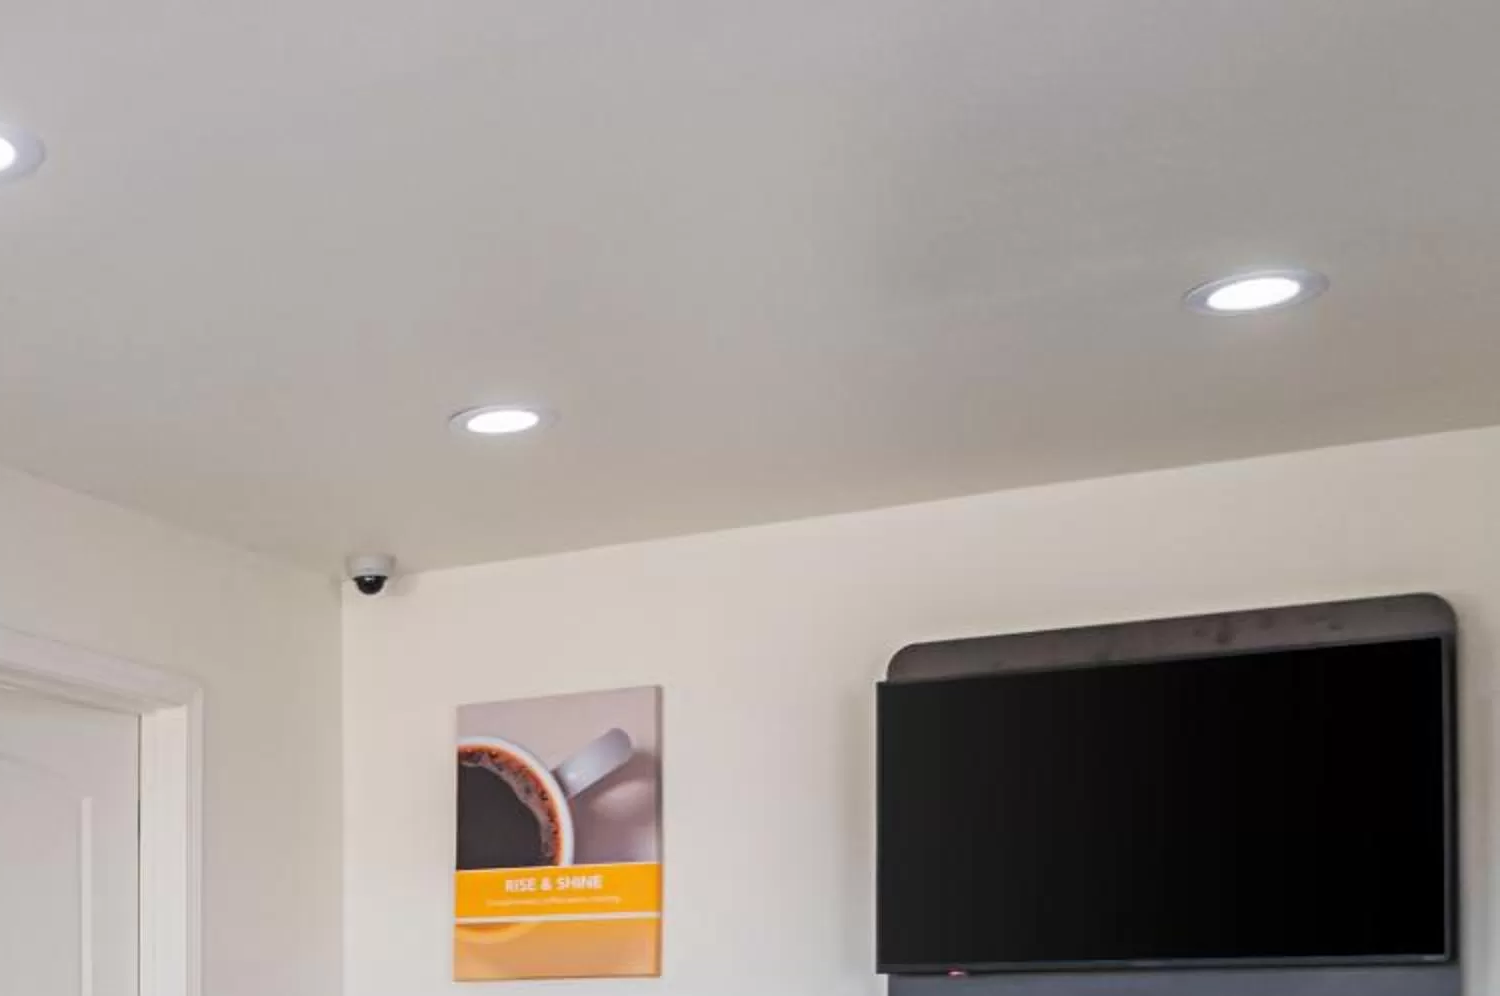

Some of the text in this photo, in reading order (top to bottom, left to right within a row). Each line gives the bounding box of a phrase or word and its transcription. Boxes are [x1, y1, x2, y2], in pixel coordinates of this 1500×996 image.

[505, 875, 603, 892] RISE & SHINE
